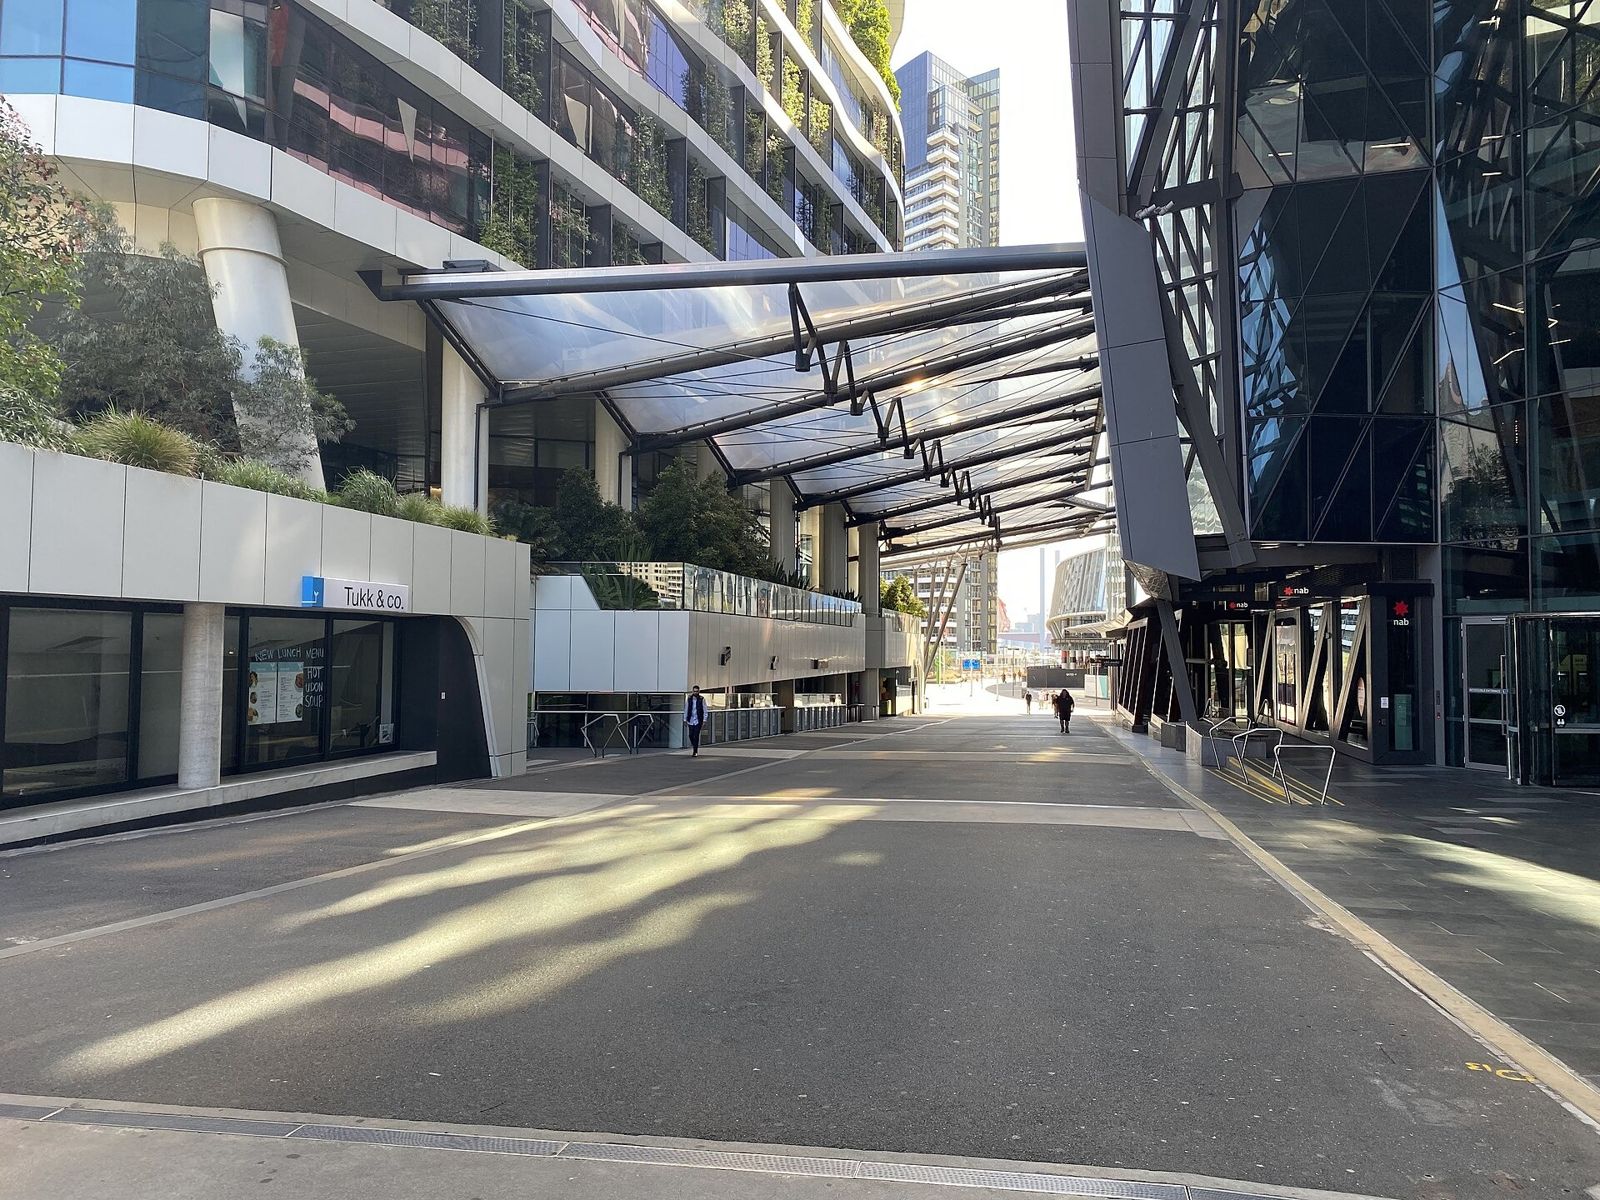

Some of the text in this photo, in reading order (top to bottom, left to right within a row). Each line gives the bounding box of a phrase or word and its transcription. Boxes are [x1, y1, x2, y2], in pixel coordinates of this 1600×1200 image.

[344, 586, 404, 610] Tukk & co.
[1393, 618, 1410, 626] nab
[255, 647, 325, 661] NEW LUNCH MENU
[307, 666, 322, 680] HOT
[305, 681, 323, 693] UDON
[305, 694, 324, 708] SOUP
